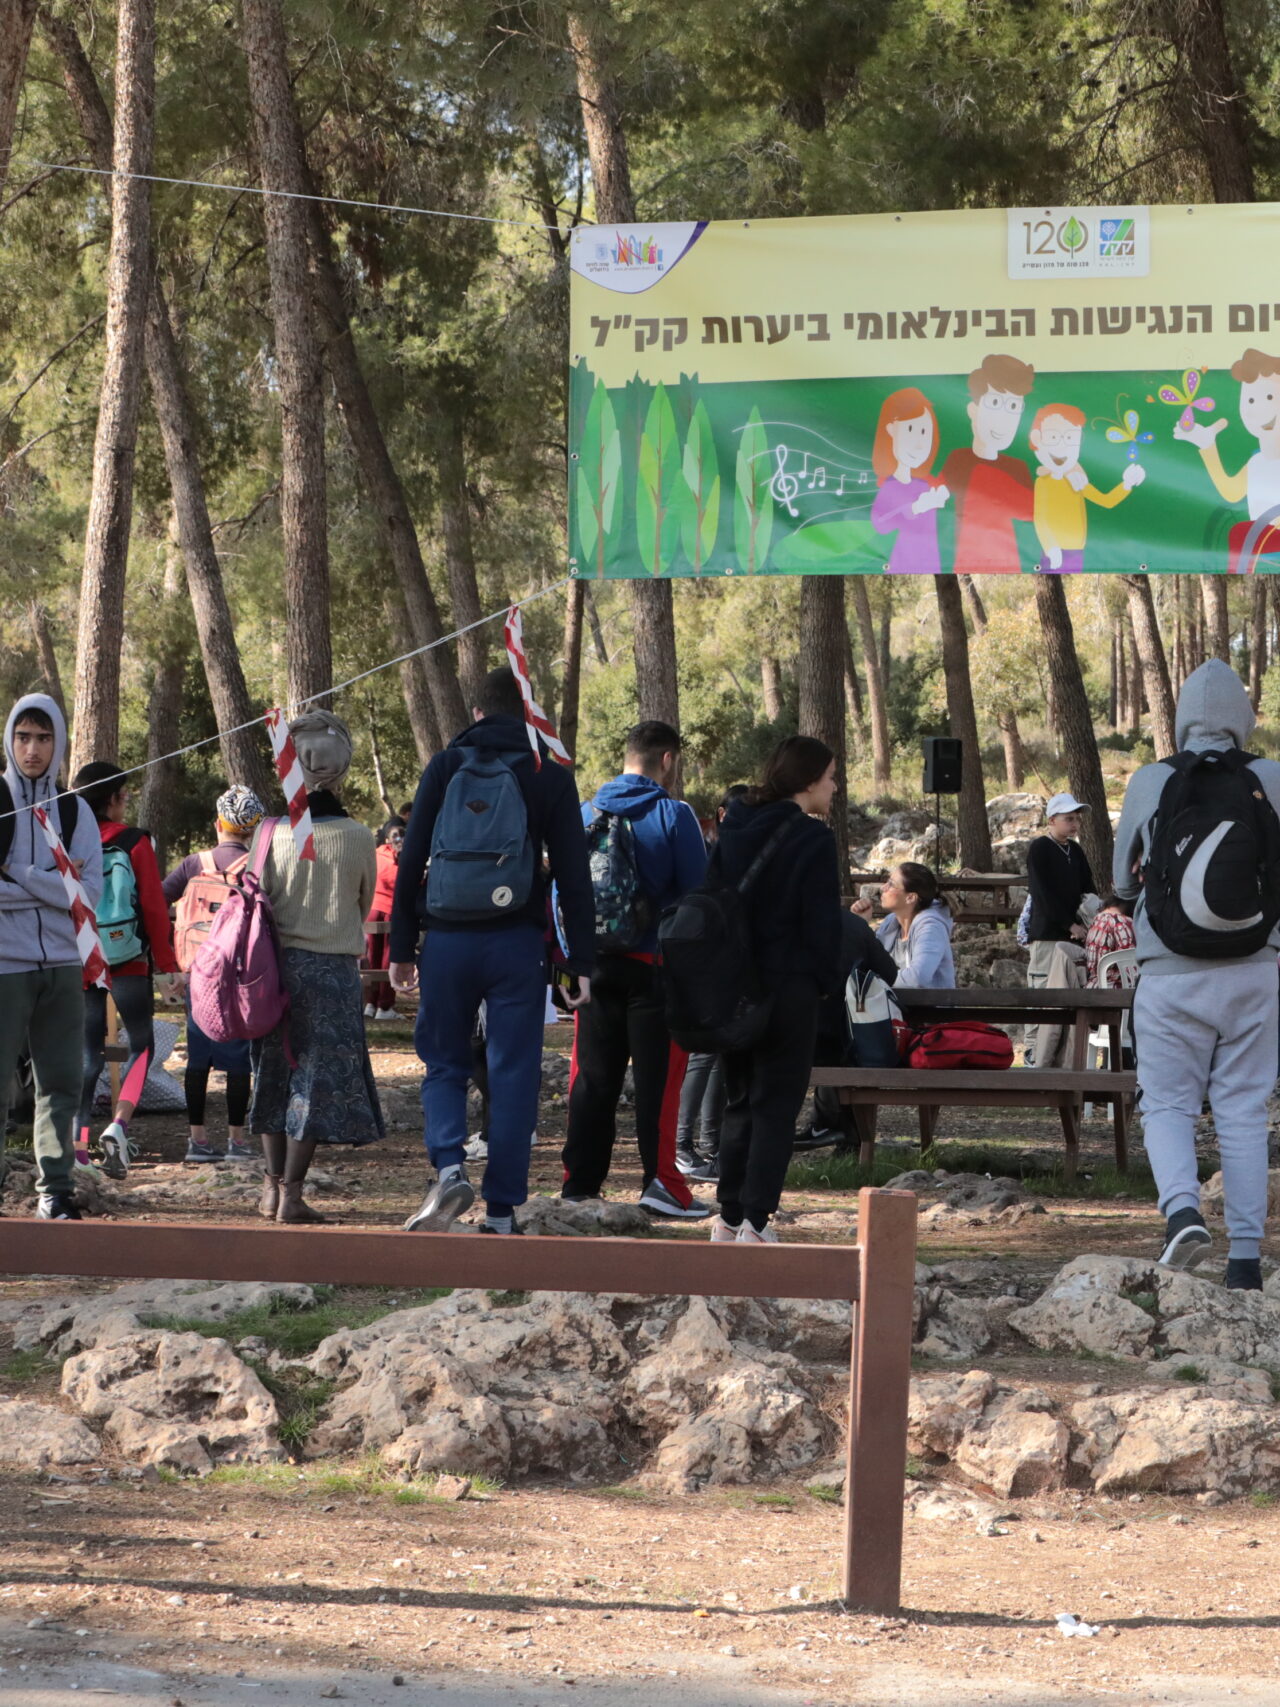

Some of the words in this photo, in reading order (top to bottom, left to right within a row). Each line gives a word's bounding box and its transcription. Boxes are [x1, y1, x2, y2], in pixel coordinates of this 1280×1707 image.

[1023, 218, 1089, 256] 120
[590, 314, 688, 353] קק"ל
[701, 313, 831, 345] ביערות
[844, 306, 1036, 340] הבינלאומי
[1050, 304, 1212, 336] הנגישות
